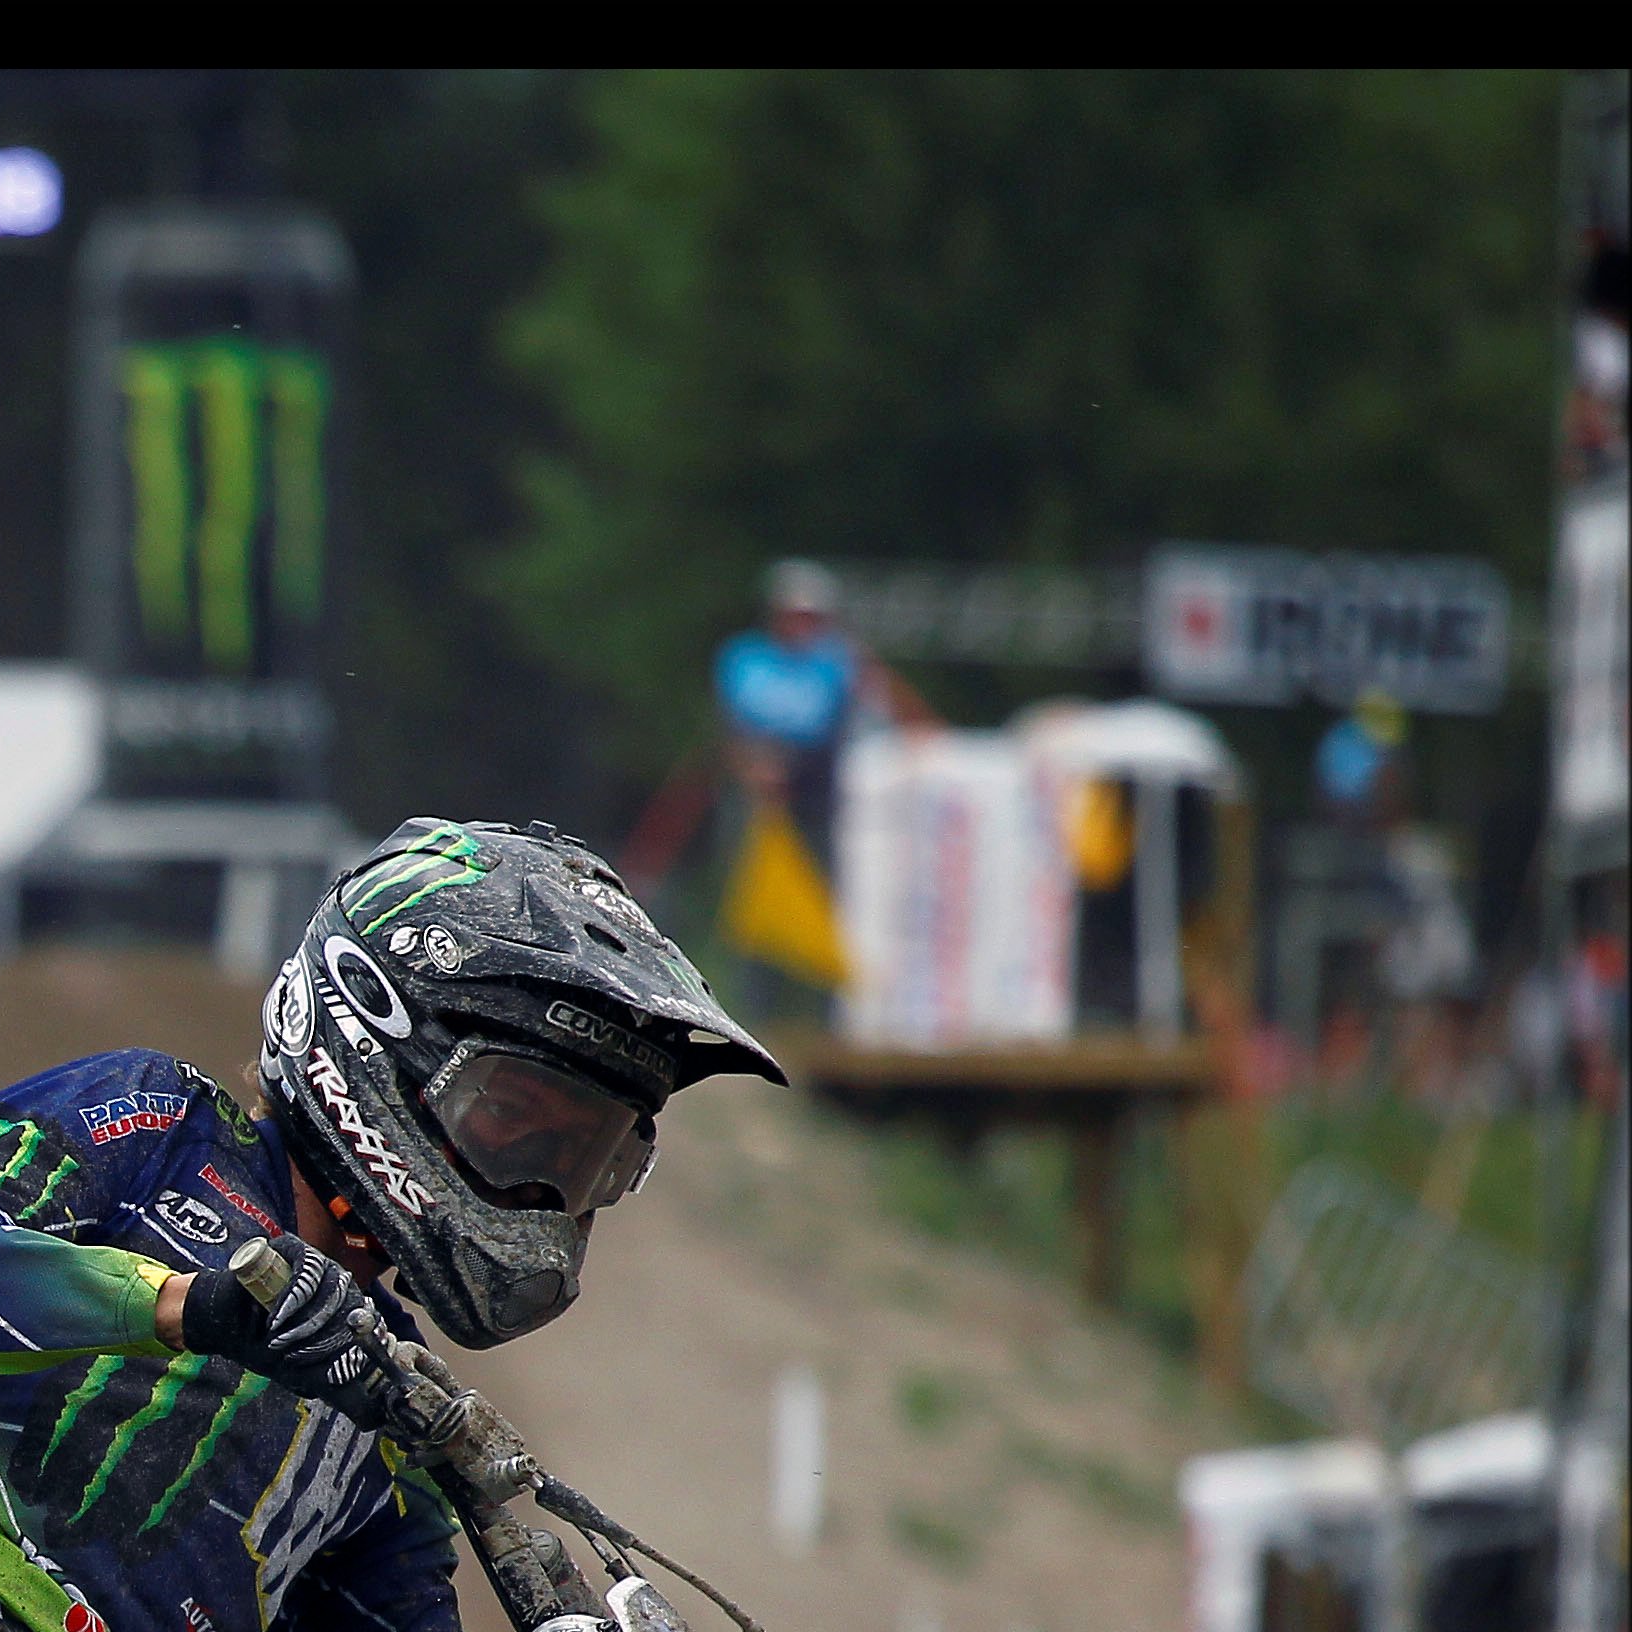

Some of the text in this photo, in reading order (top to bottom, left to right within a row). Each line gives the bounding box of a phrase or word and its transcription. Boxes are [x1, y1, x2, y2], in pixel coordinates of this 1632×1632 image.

[307, 1046, 436, 1217] TRAXXAS
[156, 1193, 228, 1241] Arai
[198, 1162, 284, 1239] BRAKIN
